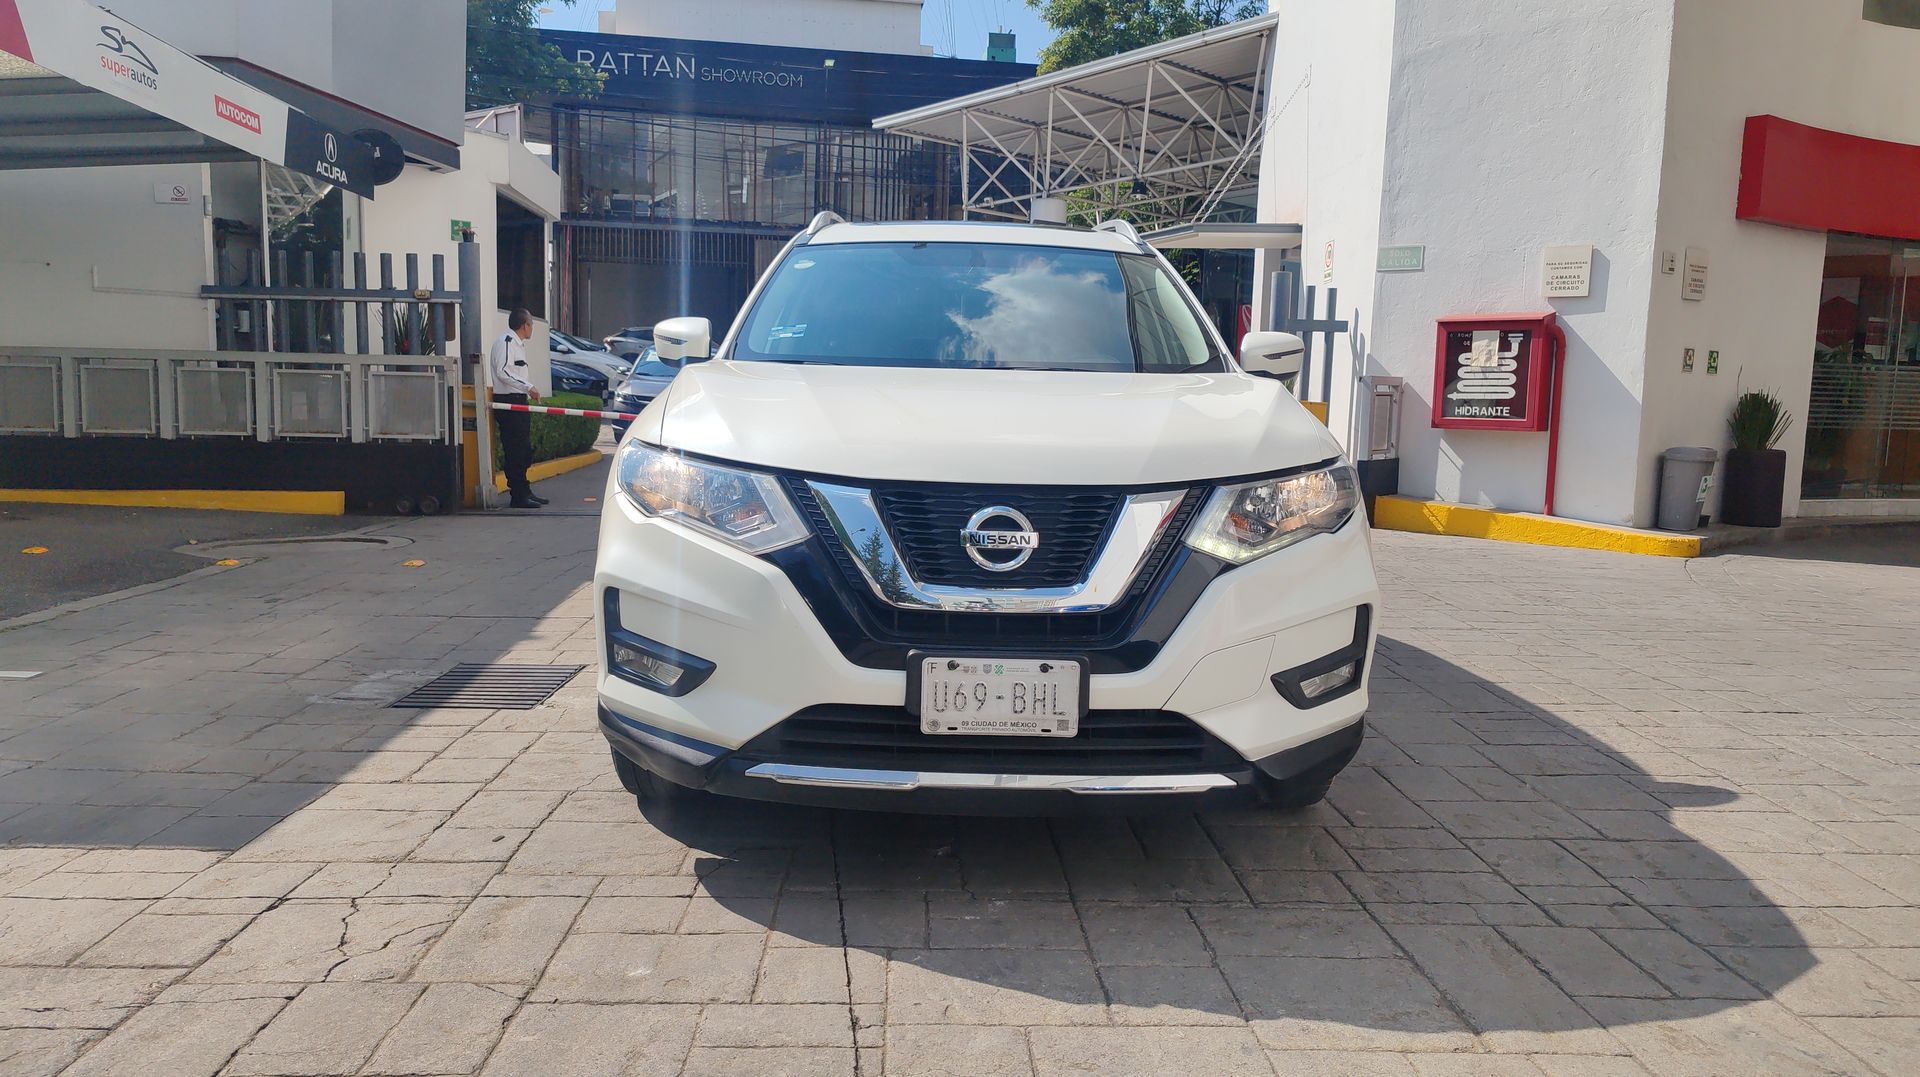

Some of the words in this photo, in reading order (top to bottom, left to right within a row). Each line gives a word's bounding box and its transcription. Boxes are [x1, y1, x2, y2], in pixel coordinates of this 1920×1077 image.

[101, 55, 157, 90] superautos
[577, 50, 695, 80] RATTAN
[701, 67, 803, 88] SHOWROOM
[218, 101, 259, 129] AUTOCOM
[316, 160, 348, 184] ACURA
[1381, 258, 1417, 267] SALIDA
[1389, 249, 1411, 257] SOLO
[1455, 406, 1510, 416] HIDRANTE
[970, 534, 1031, 545] NISSAN
[934, 680, 1067, 717] U69-BHL
